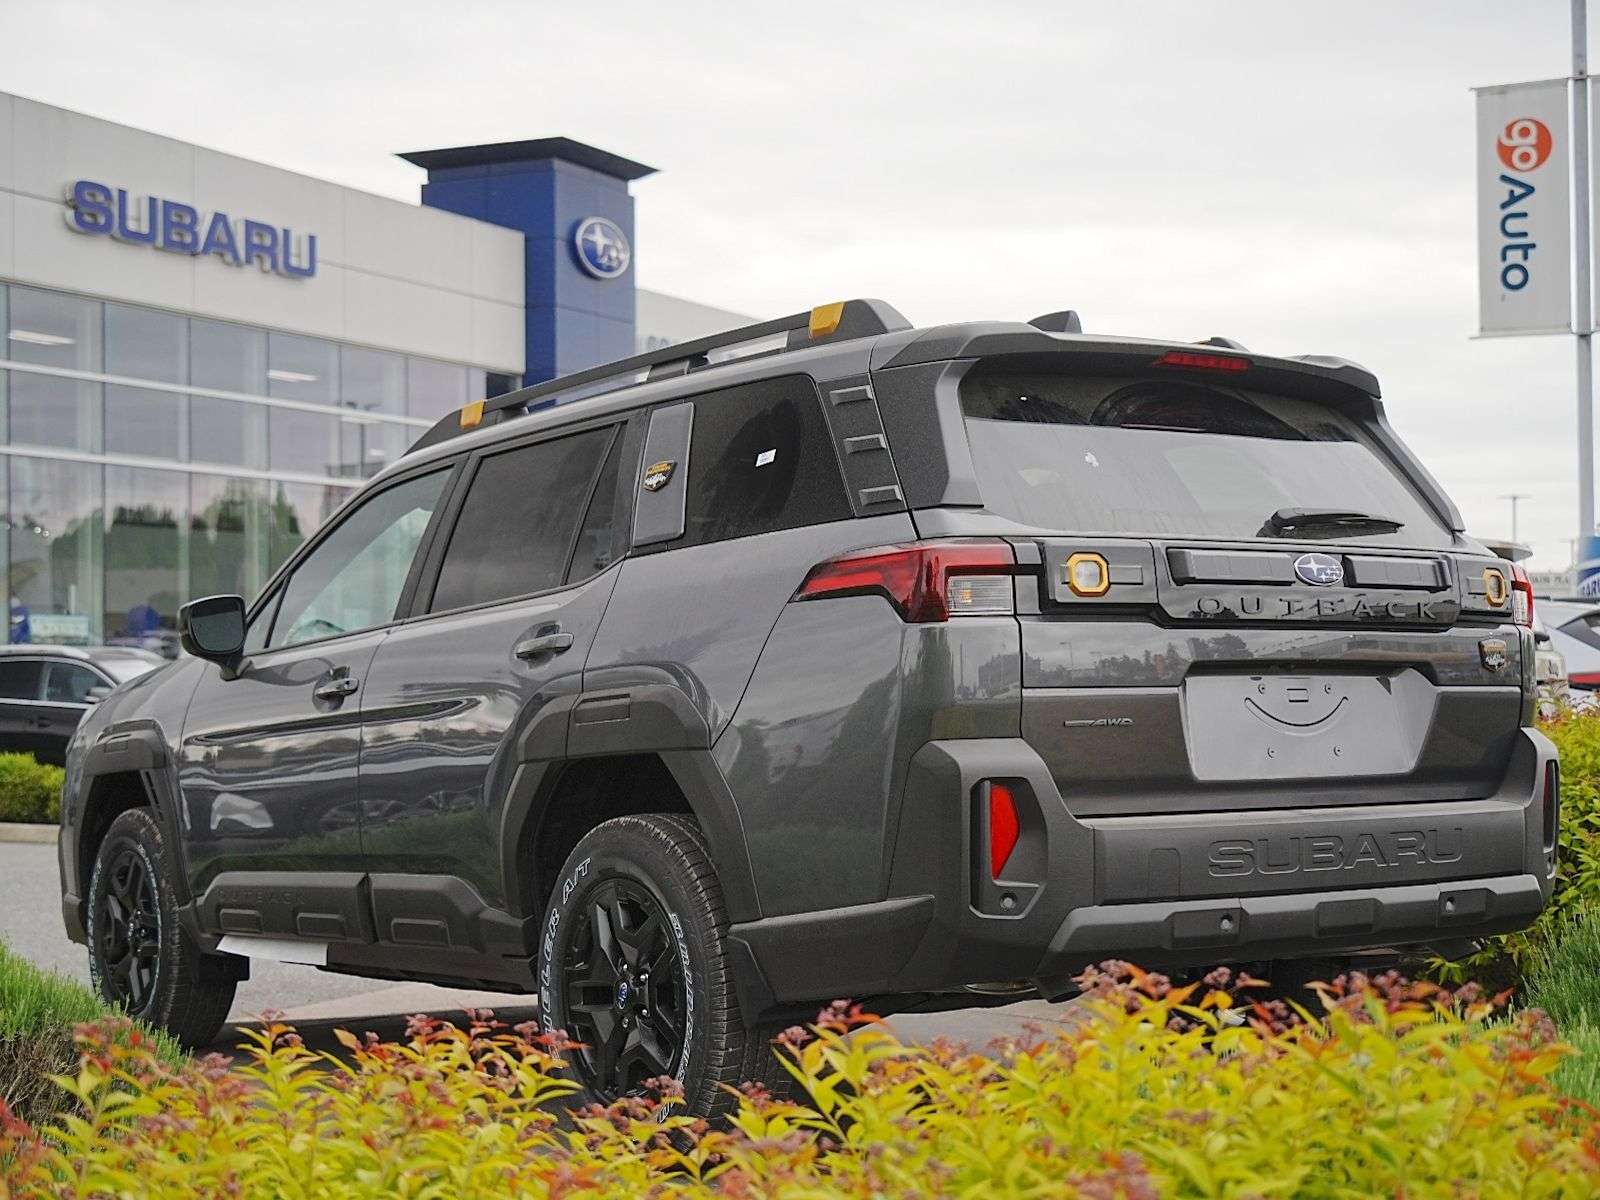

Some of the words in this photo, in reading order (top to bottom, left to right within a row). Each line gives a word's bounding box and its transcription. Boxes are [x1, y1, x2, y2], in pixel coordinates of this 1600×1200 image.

[67, 180, 317, 278] SUBARU
[1500, 174, 1536, 291] Auto
[1197, 595, 1436, 618] OUTBACK
[1089, 717, 1134, 727] AWD
[1208, 828, 1462, 877] SUBARU
[563, 857, 592, 904] A/T
